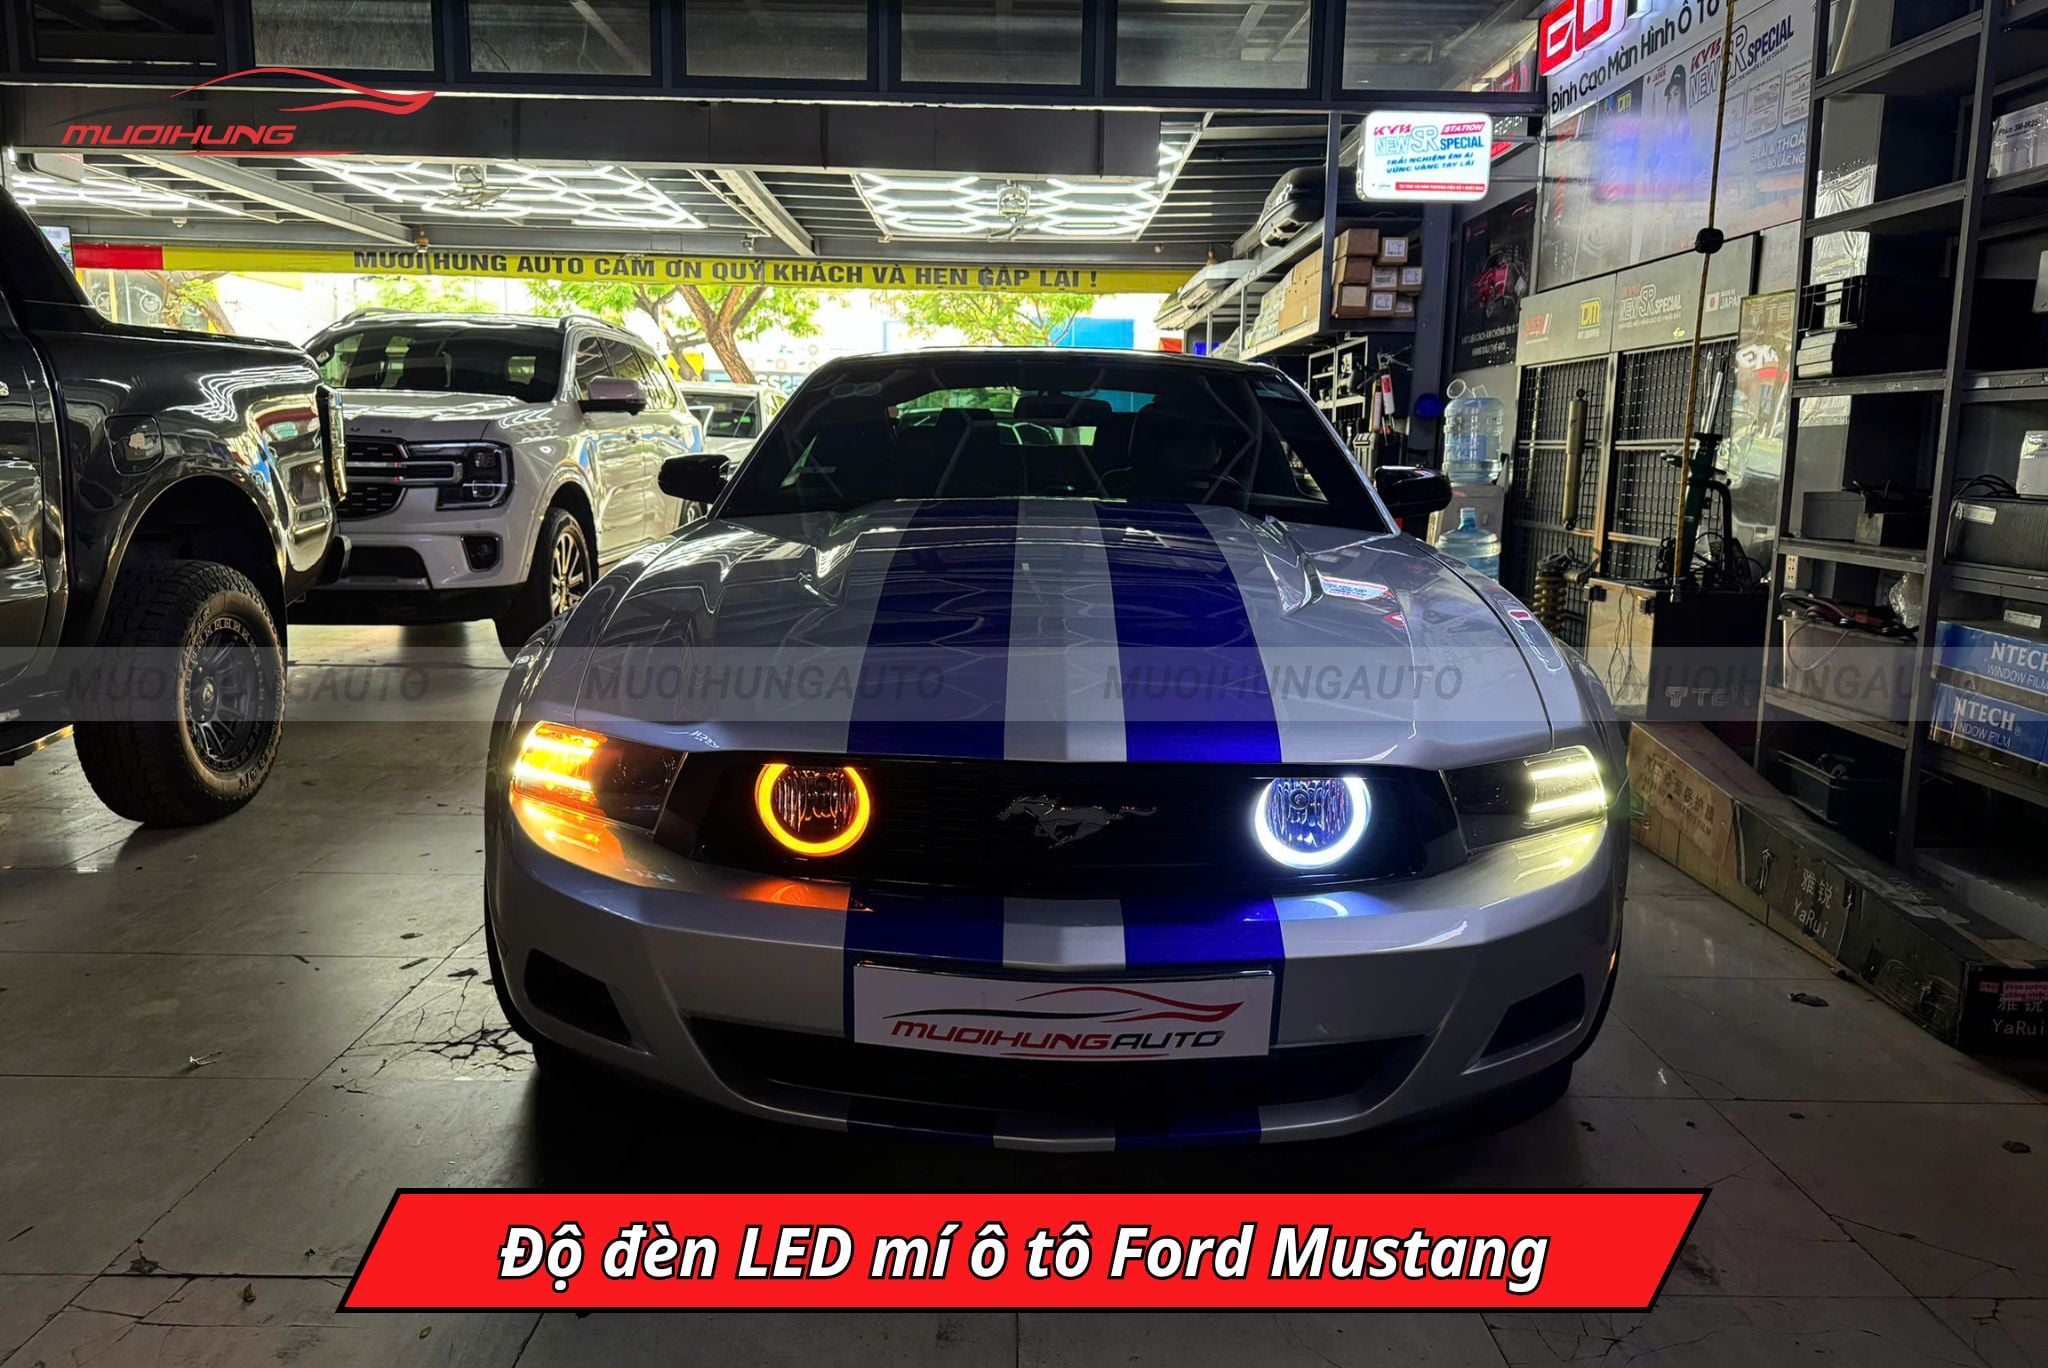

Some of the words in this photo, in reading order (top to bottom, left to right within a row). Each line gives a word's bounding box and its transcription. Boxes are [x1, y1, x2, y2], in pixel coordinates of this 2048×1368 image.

[1579, 64, 1606, 96] Cao
[1607, 43, 1639, 81] Màn
[1640, 18, 1674, 59] Hình
[1747, 15, 1794, 67] SPECIAL
[1373, 124, 1412, 136] KYB
[1444, 123, 1484, 134] STATION
[1375, 133, 1411, 156] NEW
[1440, 136, 1484, 150] SPECIAL
[516, 256, 585, 274] AUTO
[665, 258, 702, 279] ƠN
[711, 259, 763, 281] QUÝ
[773, 260, 863, 283] KHÁCH
[872, 262, 906, 285] VÀ
[914, 267, 968, 289] HẸN
[1987, 663, 2026, 686] WINDOW
[1953, 696, 2016, 732] NTECH
[1792, 897, 1829, 939] YaRui
[1992, 1018, 2045, 1036] YaRui
